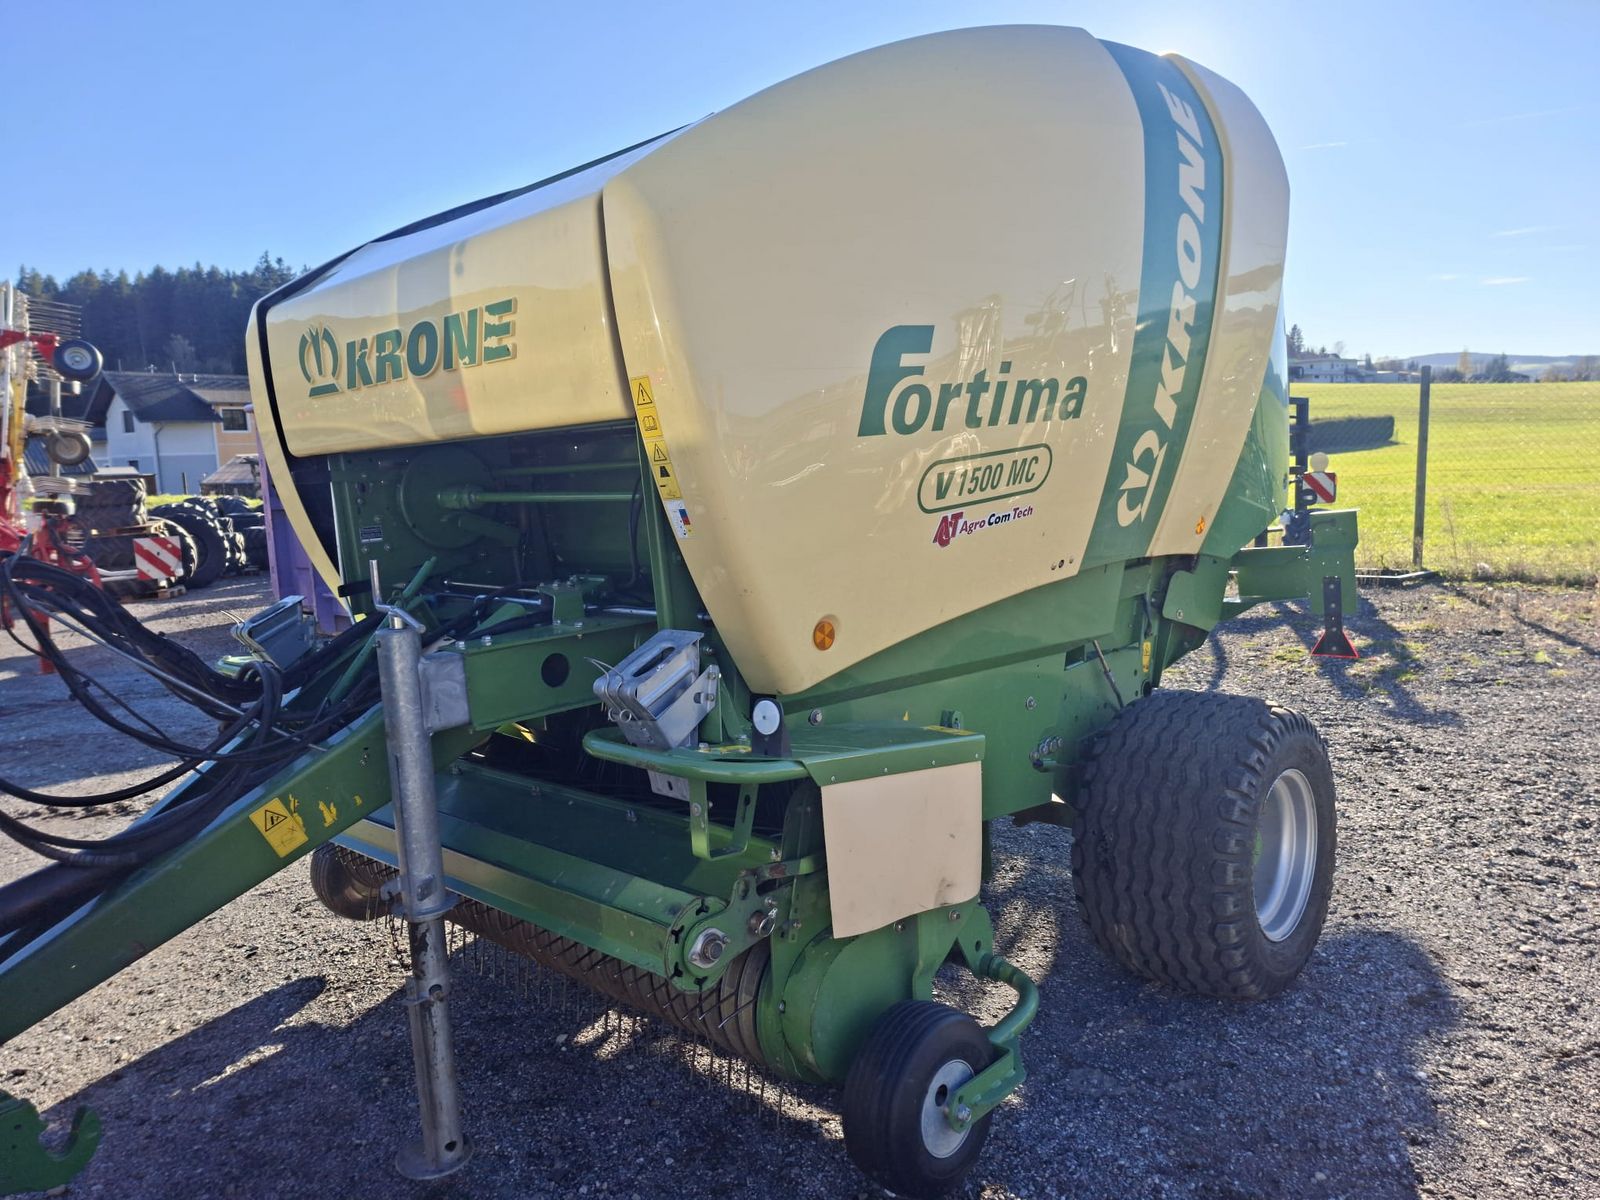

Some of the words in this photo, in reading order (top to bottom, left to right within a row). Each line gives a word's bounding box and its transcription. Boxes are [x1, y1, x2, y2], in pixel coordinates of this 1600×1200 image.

[1154, 80, 1206, 430] KRONE
[346, 297, 517, 390] KRONE
[857, 324, 1088, 437] Fortima
[935, 471, 955, 501] V
[958, 462, 1004, 497] 1500
[1006, 455, 1039, 487] MC
[959, 518, 986, 535] Agro
[987, 512, 1011, 527] Com
[1012, 505, 1034, 521] Tech
